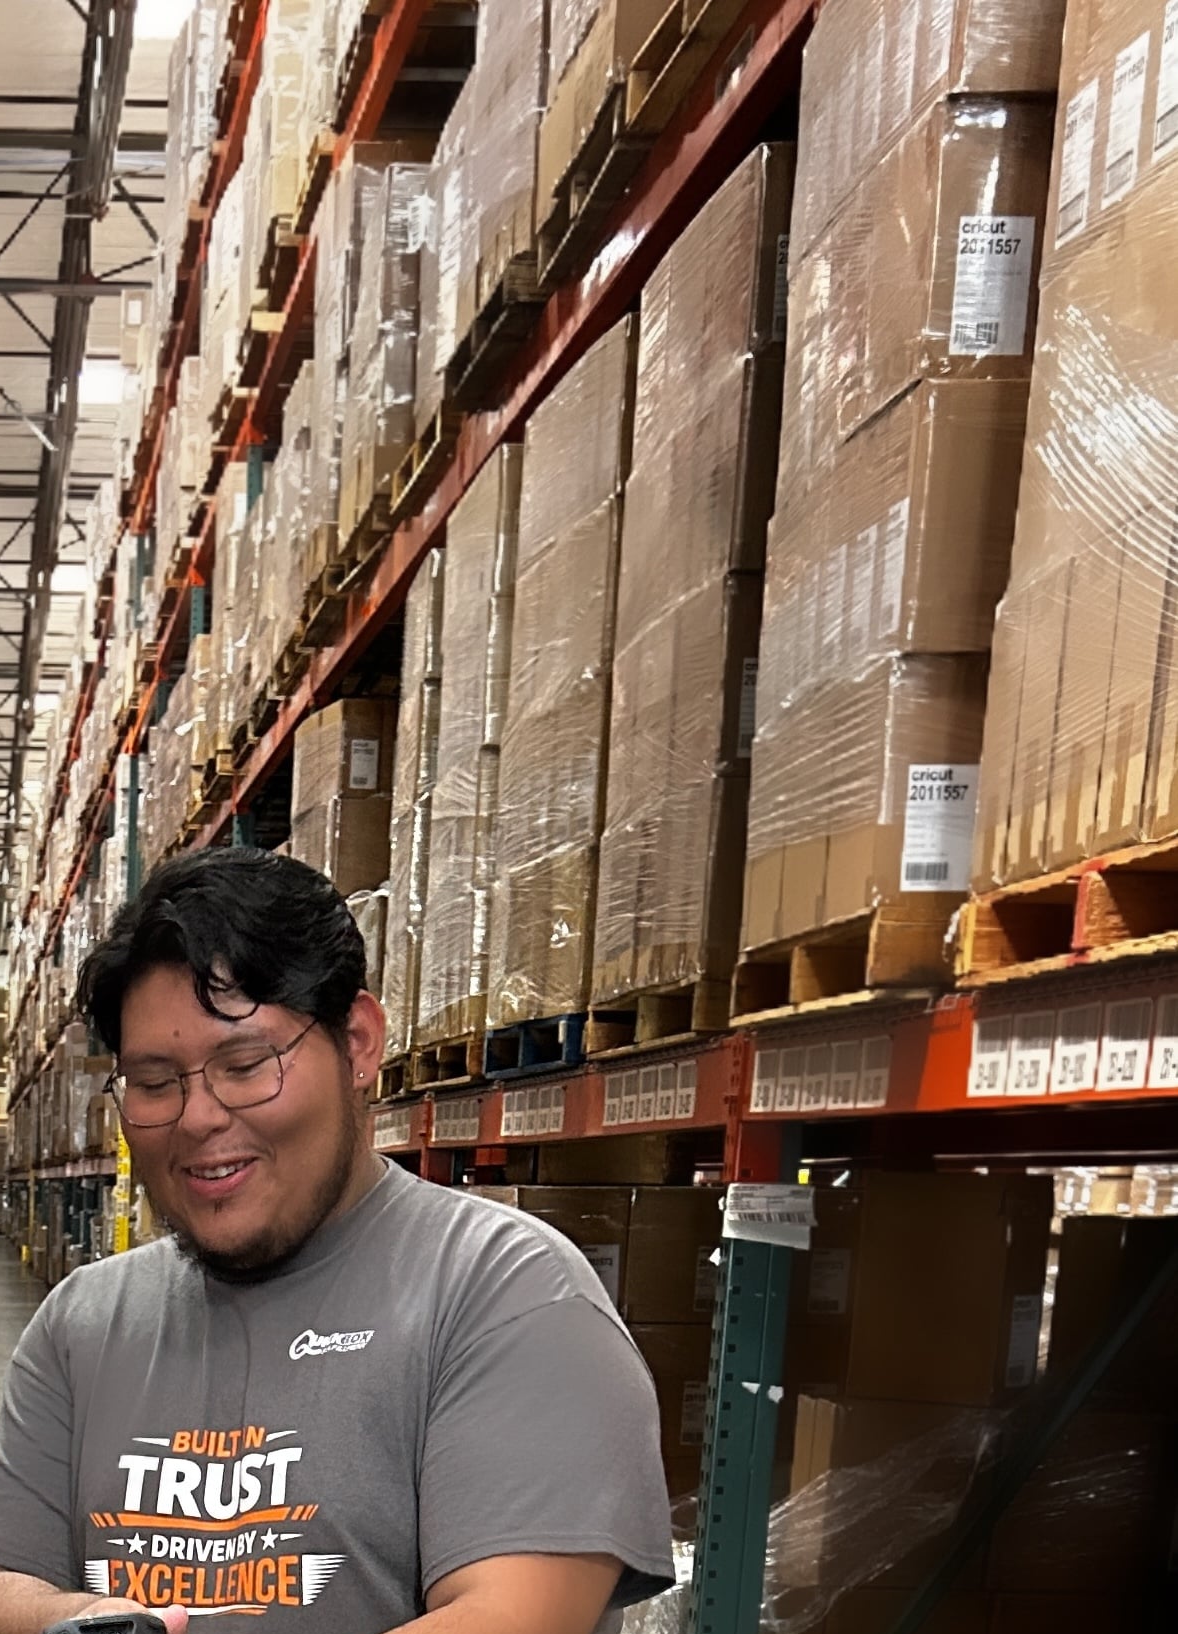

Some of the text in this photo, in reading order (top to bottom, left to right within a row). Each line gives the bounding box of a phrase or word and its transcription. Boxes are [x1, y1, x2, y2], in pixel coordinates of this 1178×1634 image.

[962, 220, 1006, 234] cricut
[960, 238, 1021, 255] 2011557
[911, 768, 953, 781] cricut
[910, 784, 969, 801] 2011557
[172, 1428, 242, 1458] BUILT
[118, 1447, 303, 1520] TRUST
[151, 1530, 257, 1562] DRIVEN BY
[109, 1555, 300, 1606] EXCELLENCE
